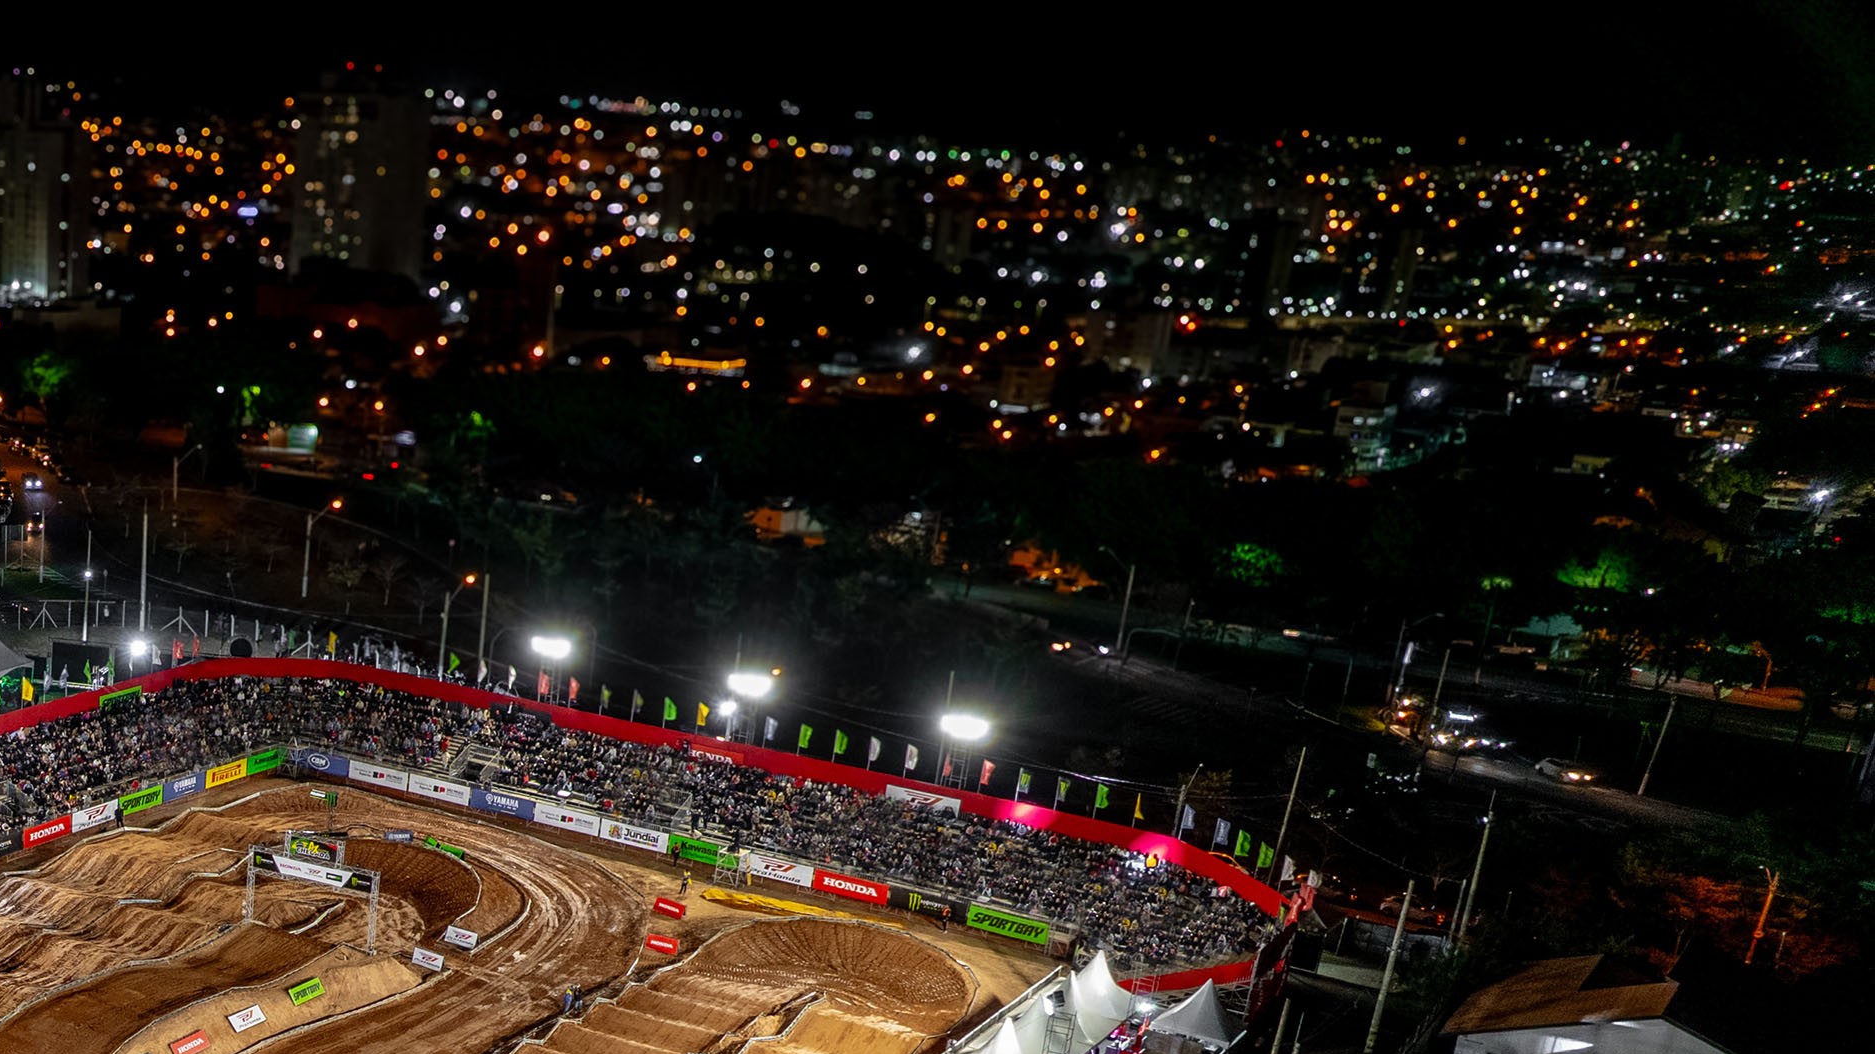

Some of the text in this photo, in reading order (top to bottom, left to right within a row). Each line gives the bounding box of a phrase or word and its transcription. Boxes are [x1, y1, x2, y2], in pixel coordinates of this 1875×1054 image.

[211, 764, 241, 783] PIRELLI
[178, 776, 197, 789] YAMAHA
[121, 789, 161, 811] SPORTBAY
[492, 794, 519, 808] YAMAHA
[29, 823, 66, 841] HONDA
[623, 827, 659, 844] Jundiaí
[680, 840, 718, 857] Kawasa
[822, 876, 878, 897] HONDA
[658, 902, 680, 914] HONDA
[971, 911, 1045, 939] SPORTBAY
[650, 940, 674, 949] HONDA
[293, 982, 321, 1001] SPORTBAY
[178, 1037, 205, 1054] HONDA
